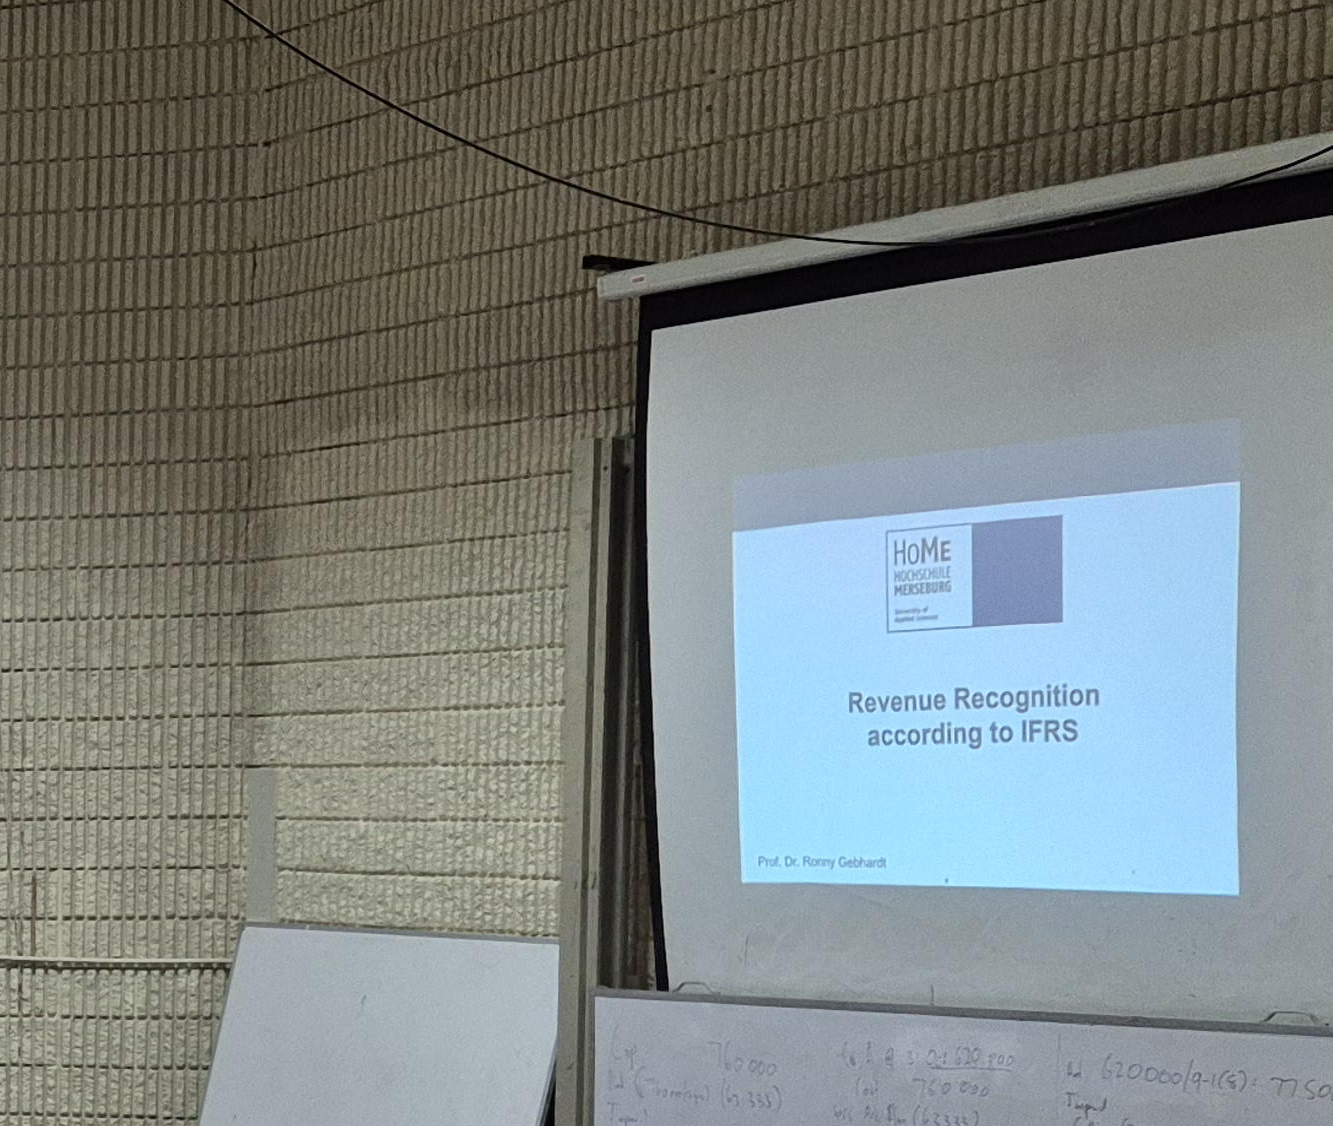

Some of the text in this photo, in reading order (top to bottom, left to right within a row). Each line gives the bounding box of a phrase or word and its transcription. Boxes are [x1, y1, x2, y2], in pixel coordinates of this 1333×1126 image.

[894, 566, 951, 583] HOCHSCHULE
[894, 580, 952, 596] MERSEBURG
[848, 684, 1100, 713] Revenue Recognition
[868, 719, 1078, 749] according to IFRS
[758, 856, 887, 870] Prof. Dr. Ronny Gebhardt
